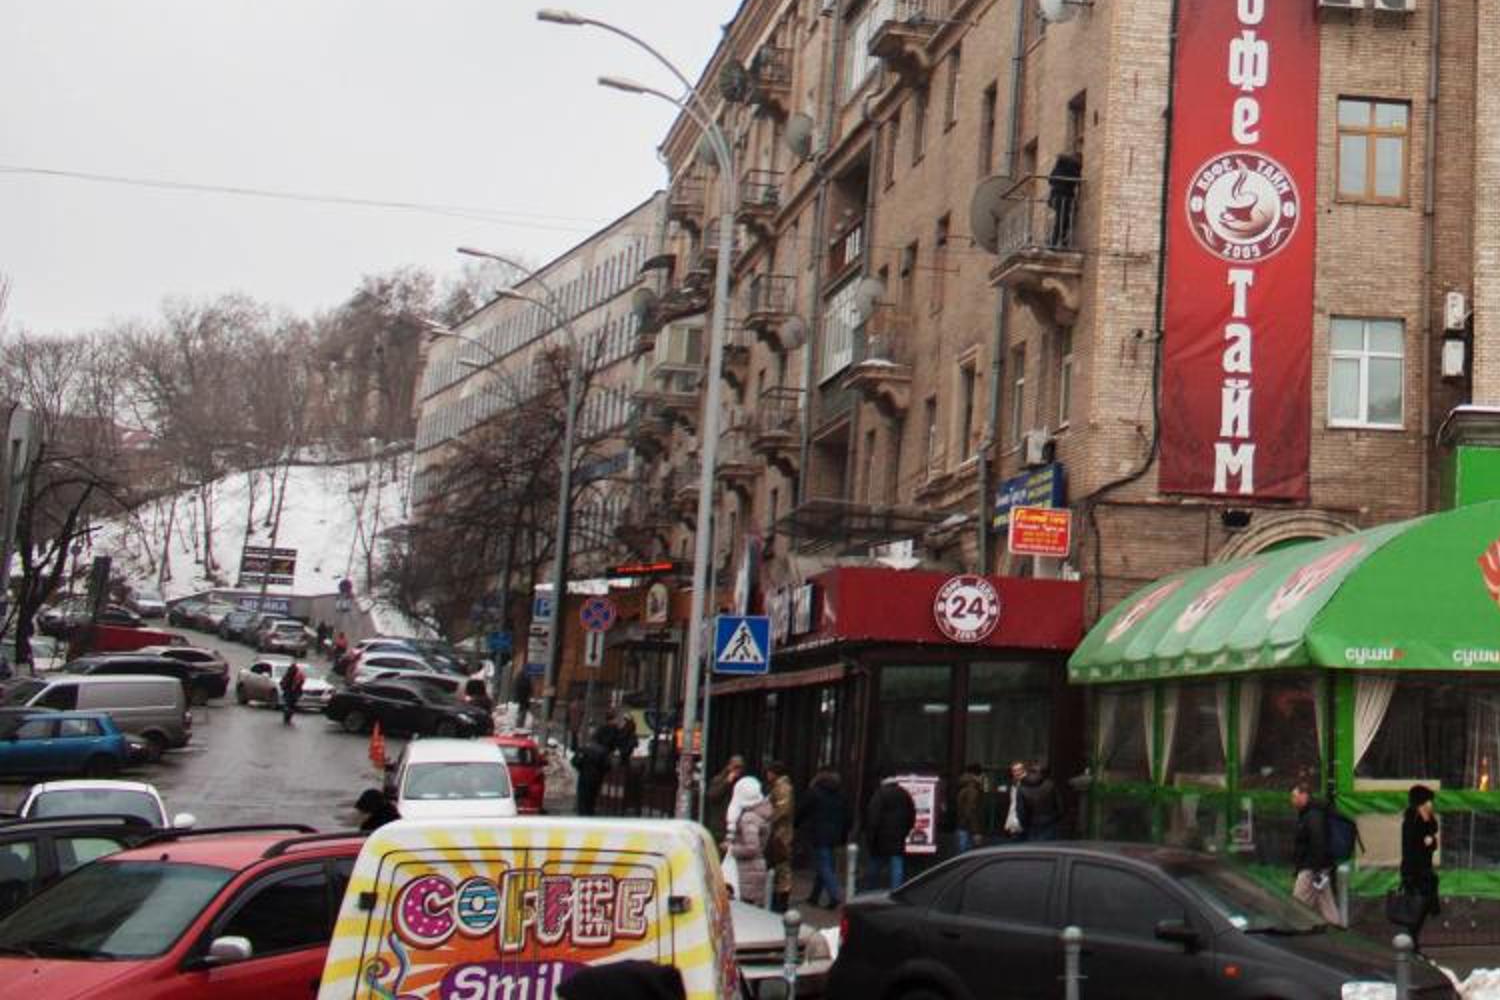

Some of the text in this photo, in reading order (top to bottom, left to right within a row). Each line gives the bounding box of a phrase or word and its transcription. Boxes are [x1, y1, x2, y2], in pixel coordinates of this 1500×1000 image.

[951, 595, 986, 619] 24
[396, 867, 655, 951] COFFEE
[449, 961, 563, 1000] Smil
